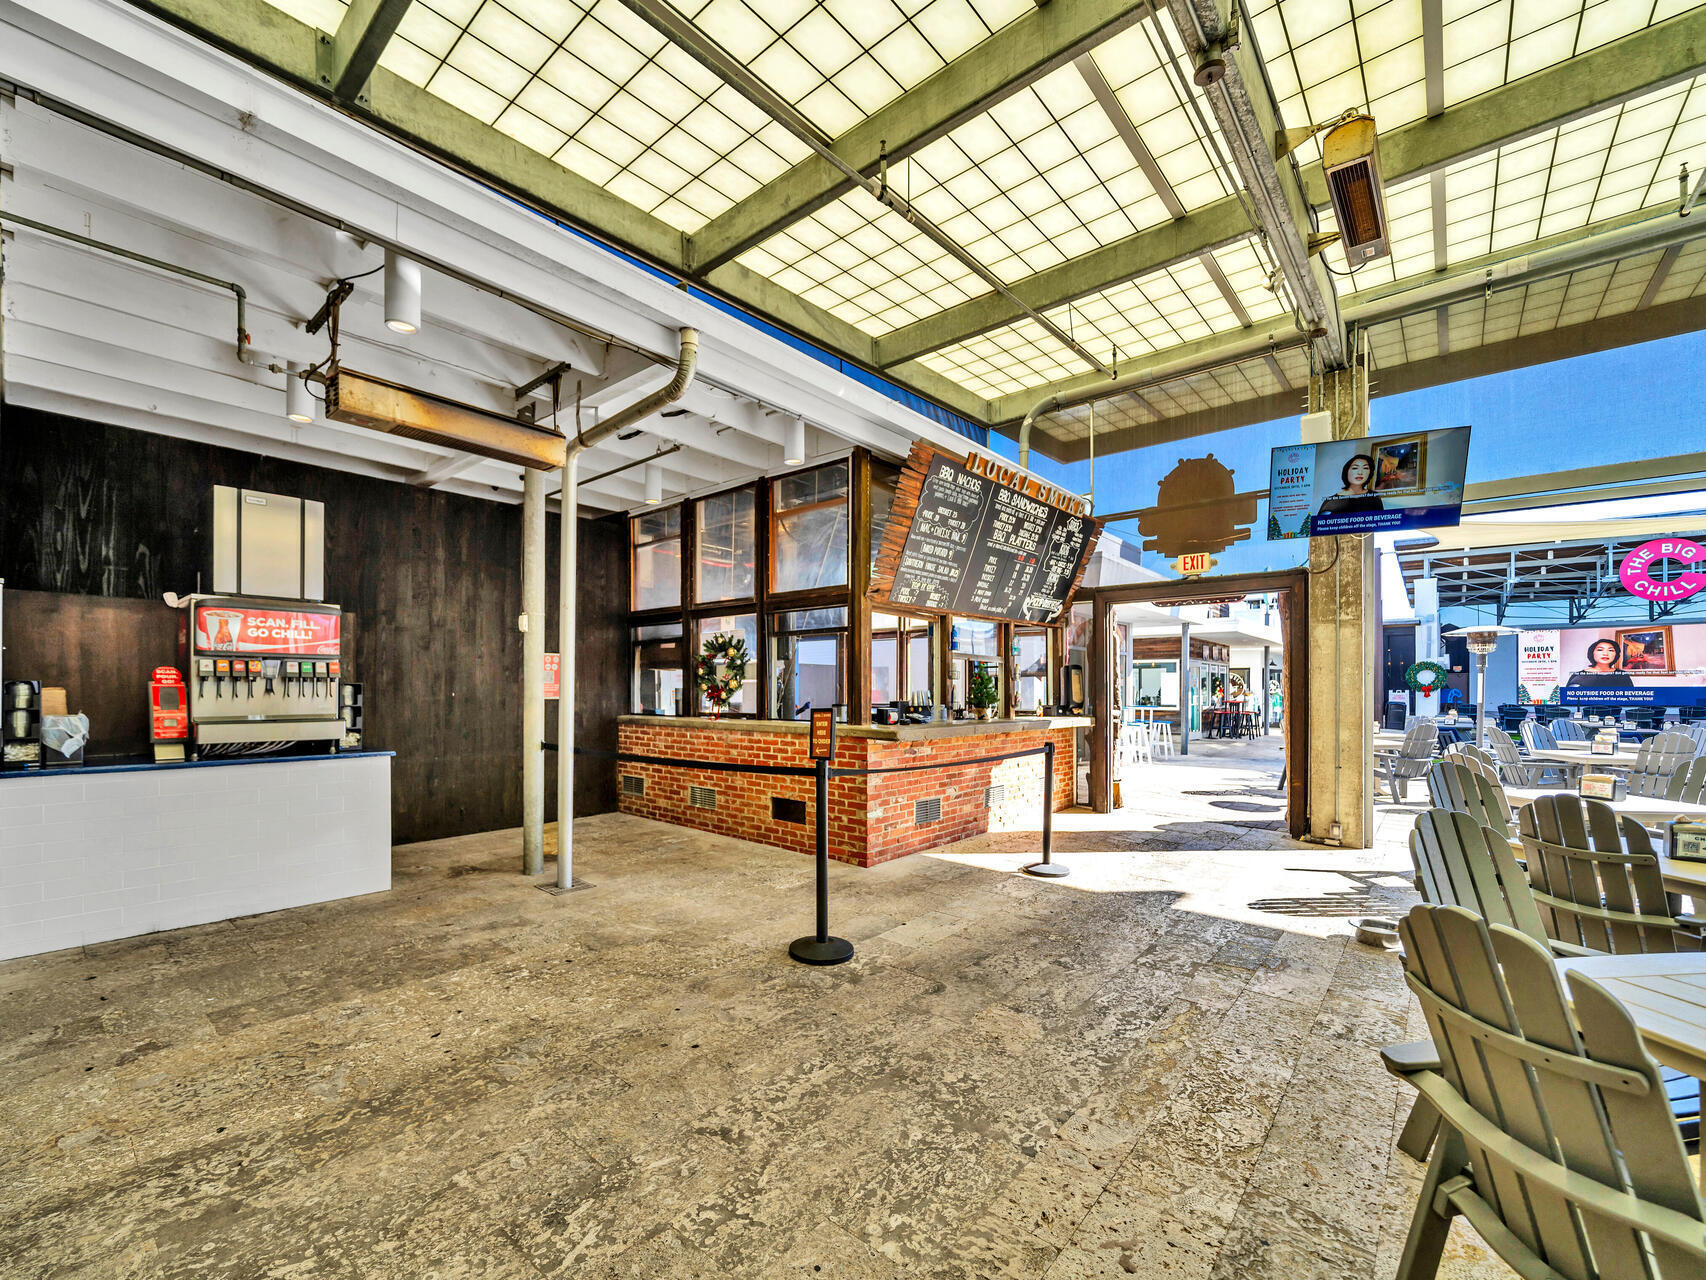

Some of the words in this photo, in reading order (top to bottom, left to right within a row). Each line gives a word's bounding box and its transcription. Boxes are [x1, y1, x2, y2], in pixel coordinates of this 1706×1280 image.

[938, 464, 956, 482] BBQ
[956, 472, 982, 492] NACHOS
[1278, 467, 1309, 477] HOLIDAY
[1280, 475, 1305, 485] PARTY
[972, 452, 1031, 494] LOCAL
[1038, 484, 1086, 517] SMOKE
[997, 487, 1013, 503] BBQ
[1010, 493, 1050, 519] SANDWICHES
[1326, 517, 1349, 525] OUTSIDE
[1373, 513, 1402, 521] BEVERAGE
[992, 528, 1007, 542] BBQ
[1008, 534, 1038, 551] PLATTERS
[1183, 554, 1205, 571] EXIT
[1627, 548, 1655, 576] THE
[1661, 542, 1697, 559] BIG
[1634, 580, 1697, 597] CHILL
[247, 617, 289, 628] SCAN.
[247, 627, 269, 637] GO
[271, 629, 313, 639] CHILL!
